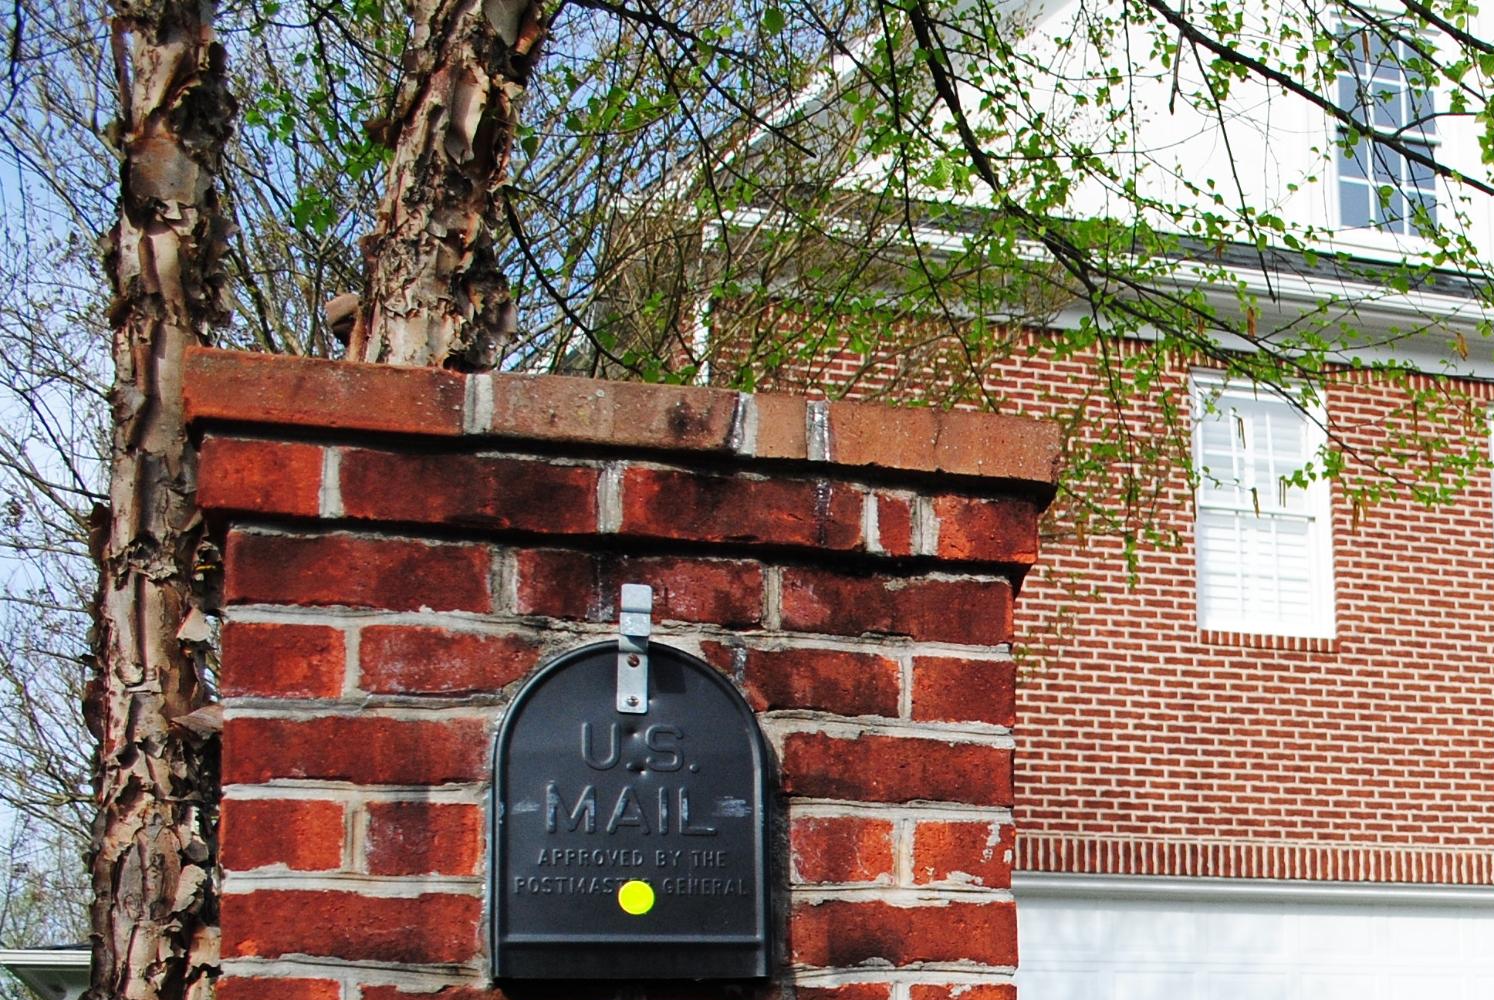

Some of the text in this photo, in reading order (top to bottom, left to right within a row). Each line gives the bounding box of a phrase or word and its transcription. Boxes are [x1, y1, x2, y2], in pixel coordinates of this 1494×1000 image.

[581, 721, 700, 772] U.S.
[545, 783, 718, 836] MAIL
[537, 848, 727, 867] APPROVED BY THE
[513, 876, 748, 896] POSTMAST GENERAL
